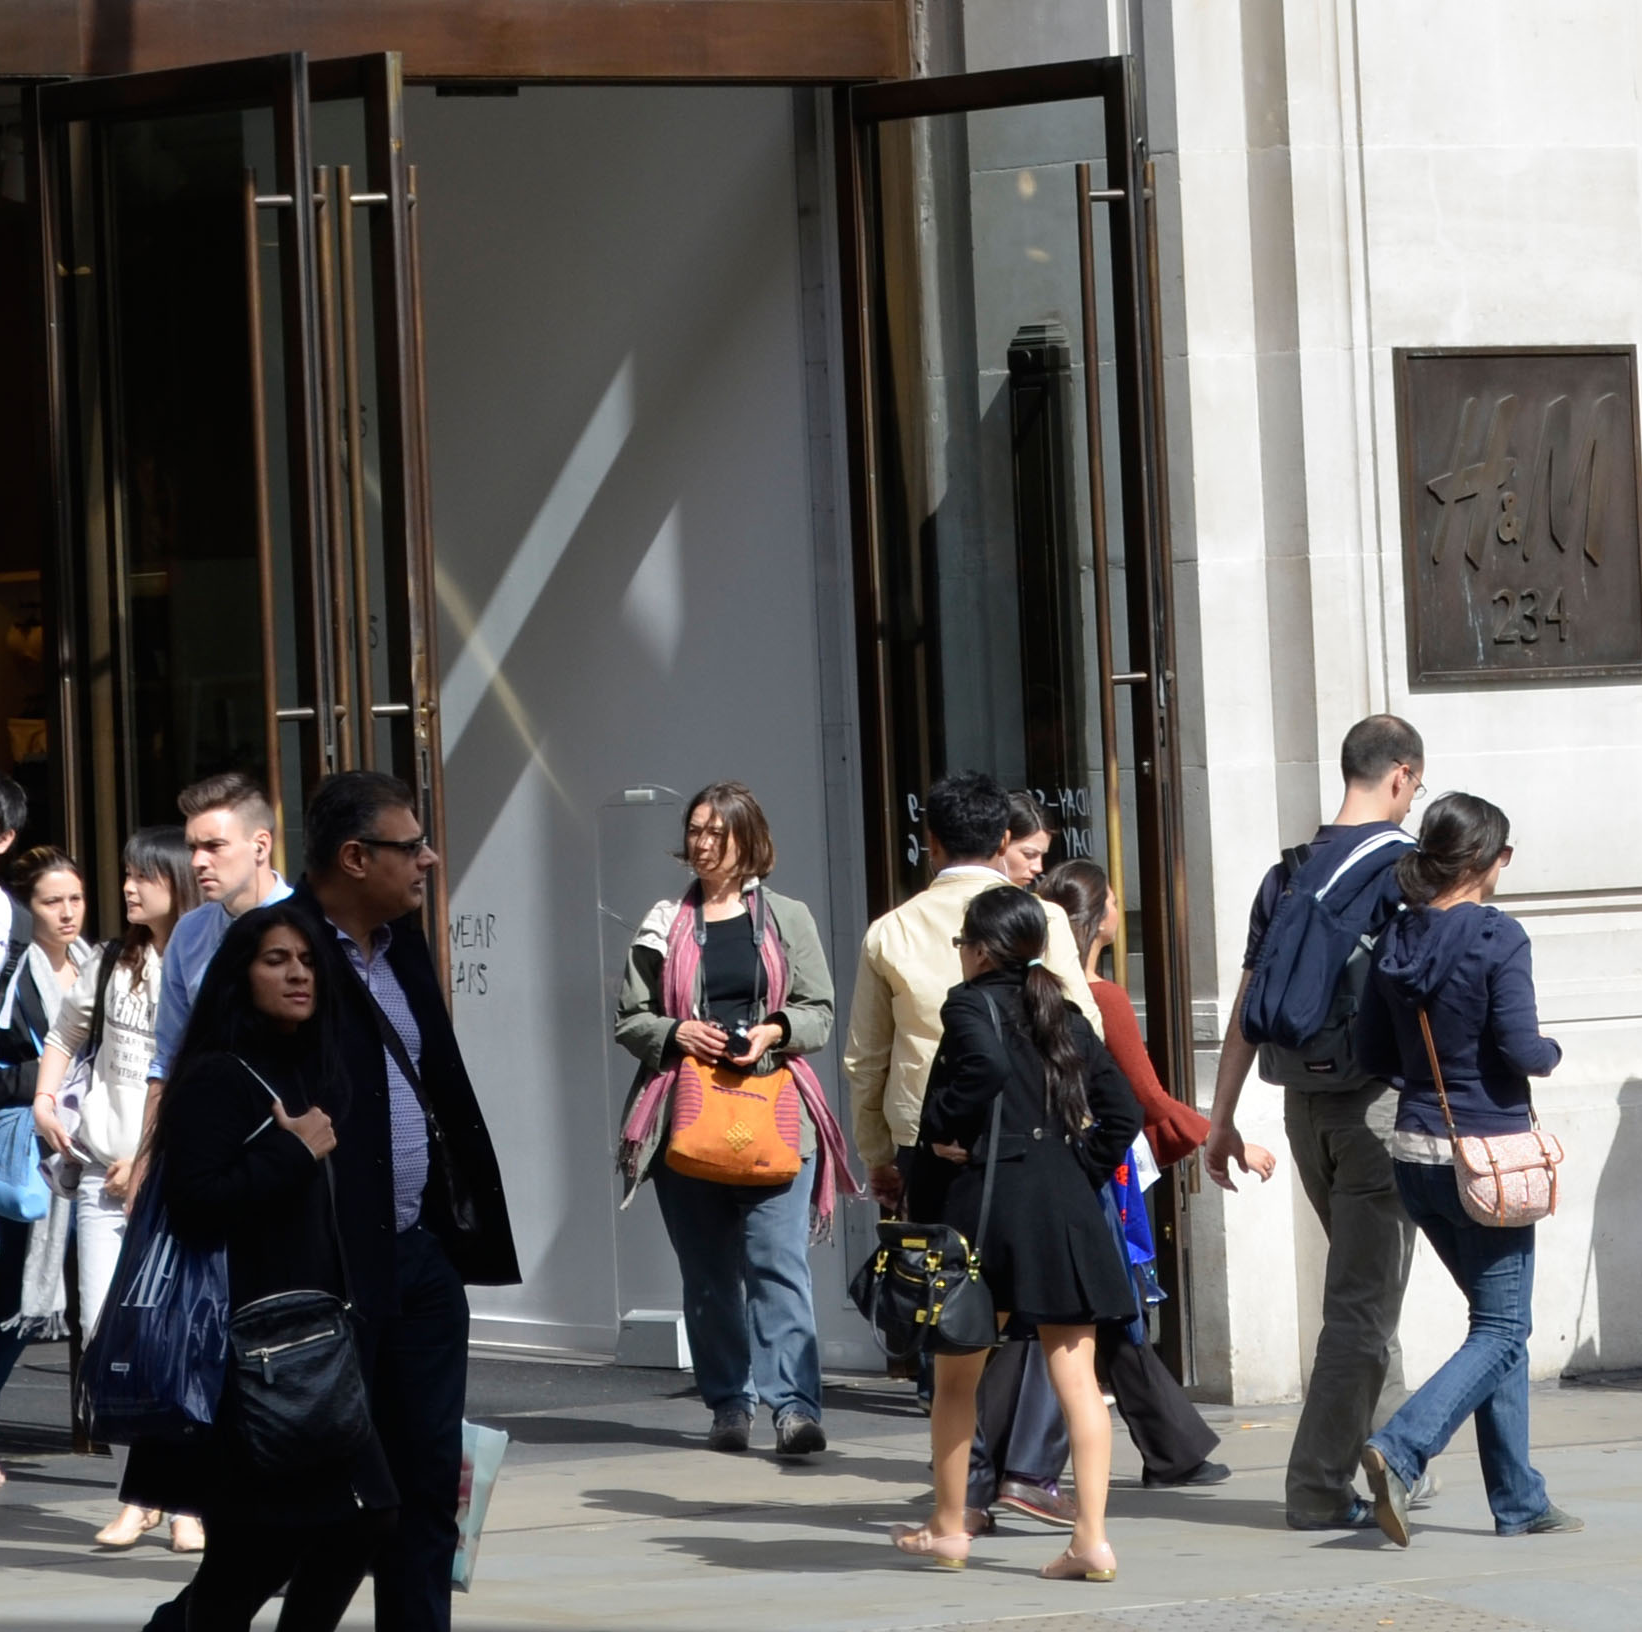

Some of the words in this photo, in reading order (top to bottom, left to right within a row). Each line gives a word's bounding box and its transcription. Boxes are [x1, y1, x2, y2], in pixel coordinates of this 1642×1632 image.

[1425, 392, 1620, 571] H&M
[1491, 587, 1570, 646] 234
[451, 961, 488, 995] ARS
